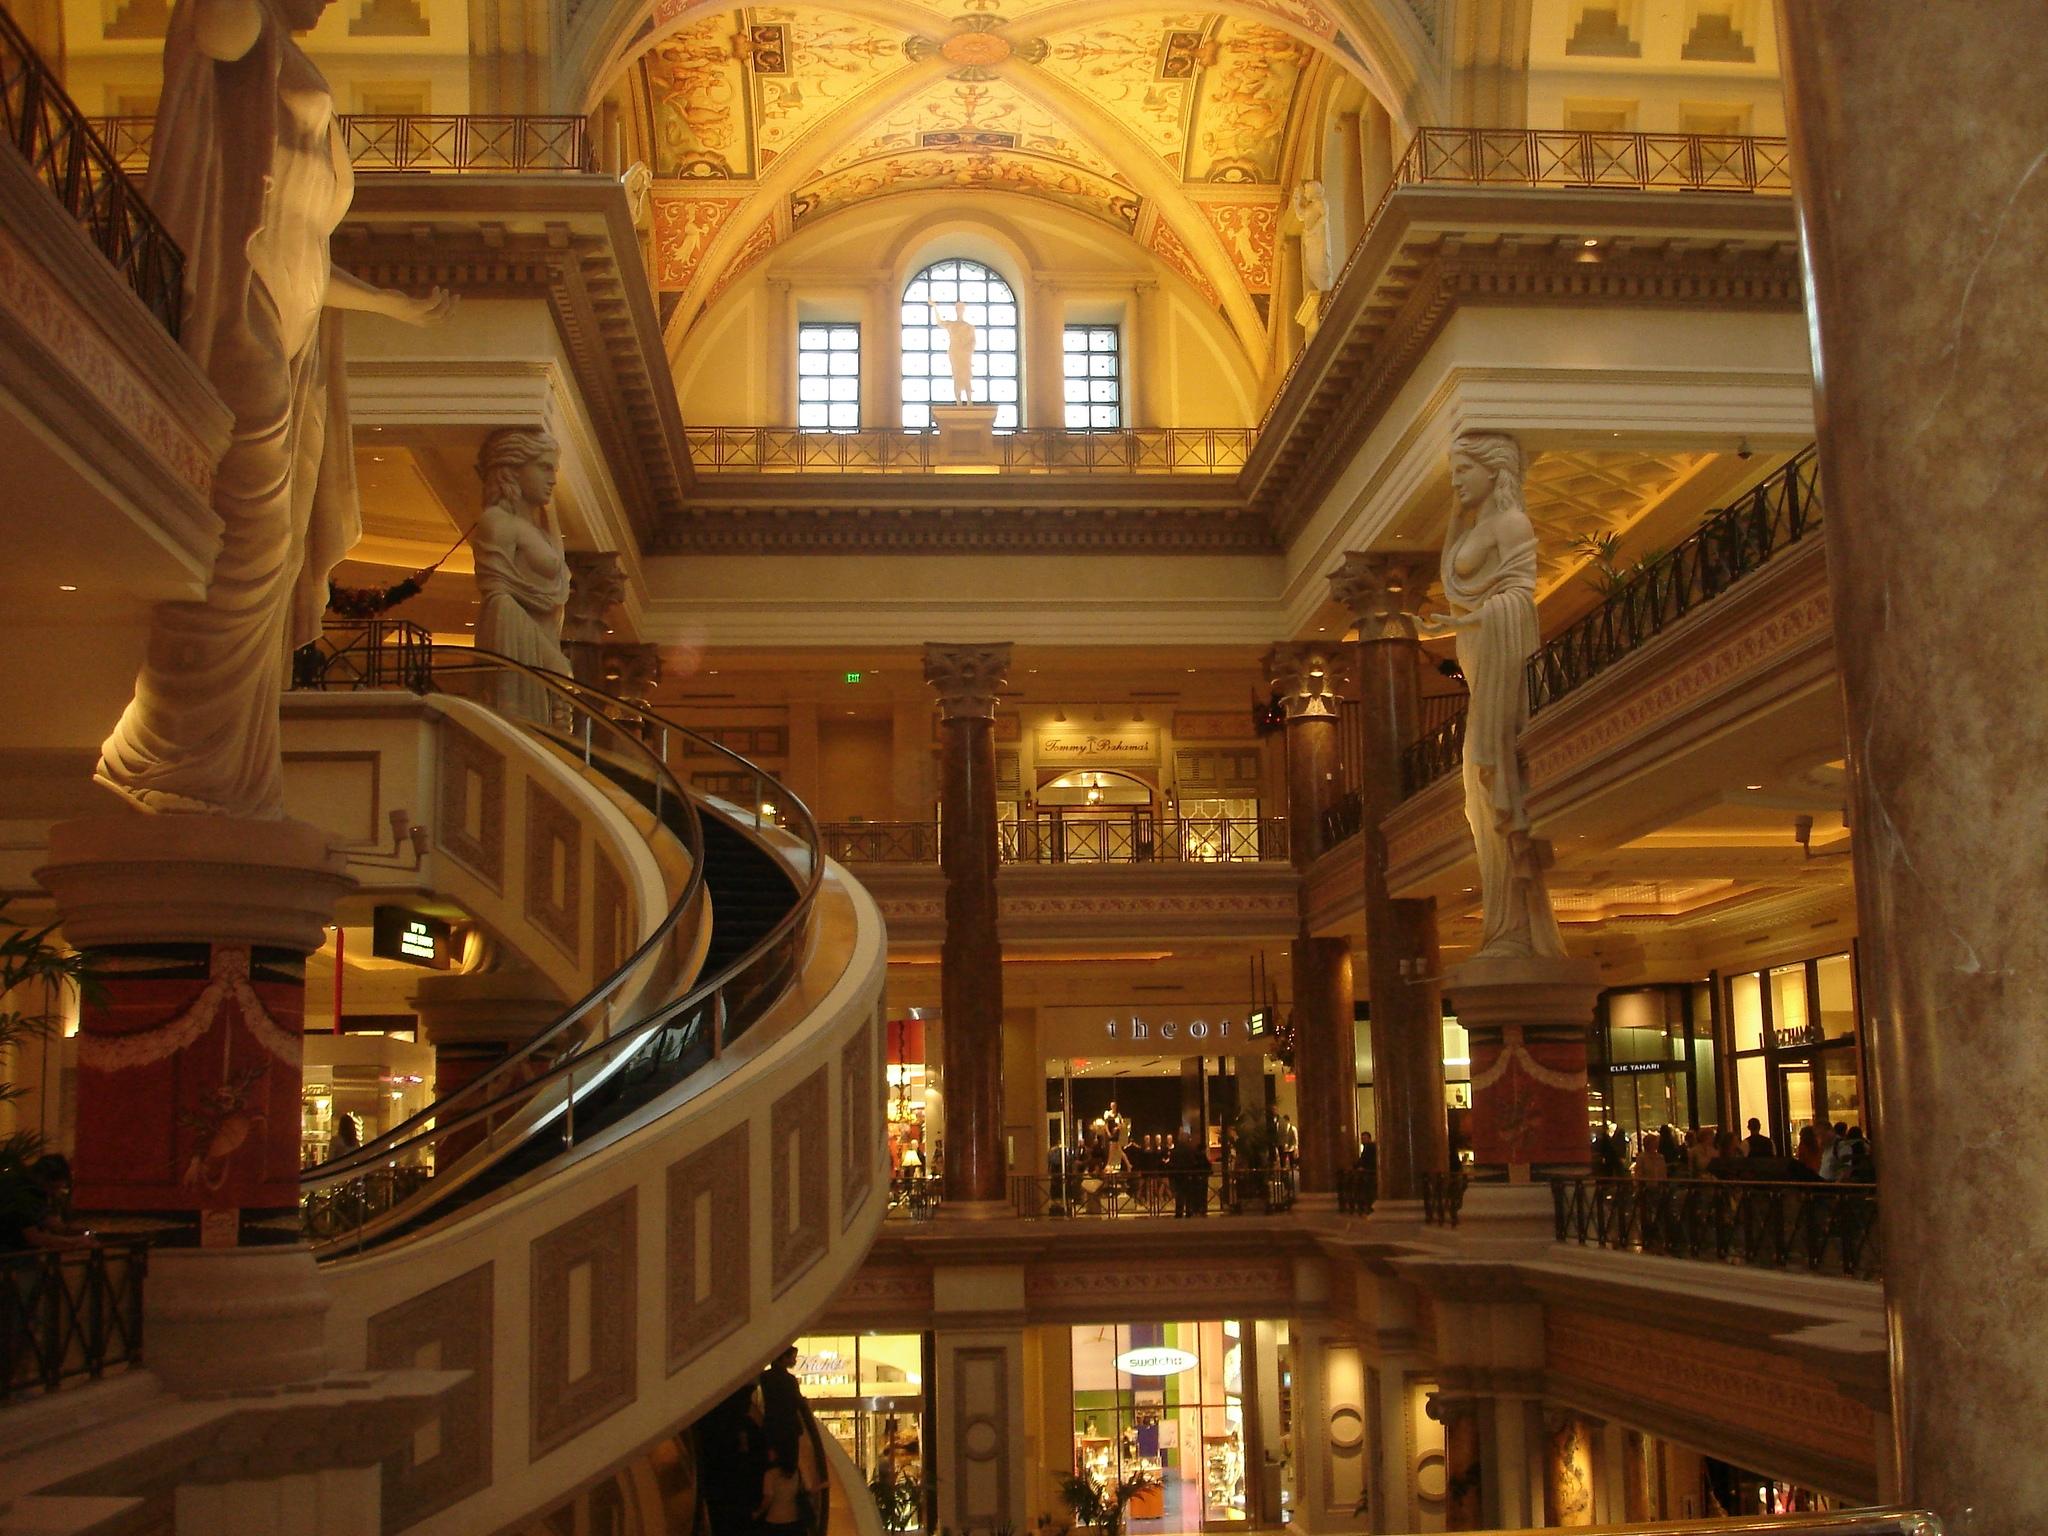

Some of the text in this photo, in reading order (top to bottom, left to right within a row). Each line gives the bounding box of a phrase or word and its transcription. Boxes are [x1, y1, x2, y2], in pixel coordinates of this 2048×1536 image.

[847, 673, 860, 683] EXIT
[1045, 739, 1087, 756] Tommy
[1610, 1063, 1660, 1073] ELIE TAHARI
[1129, 1356, 1173, 1368] swatch
